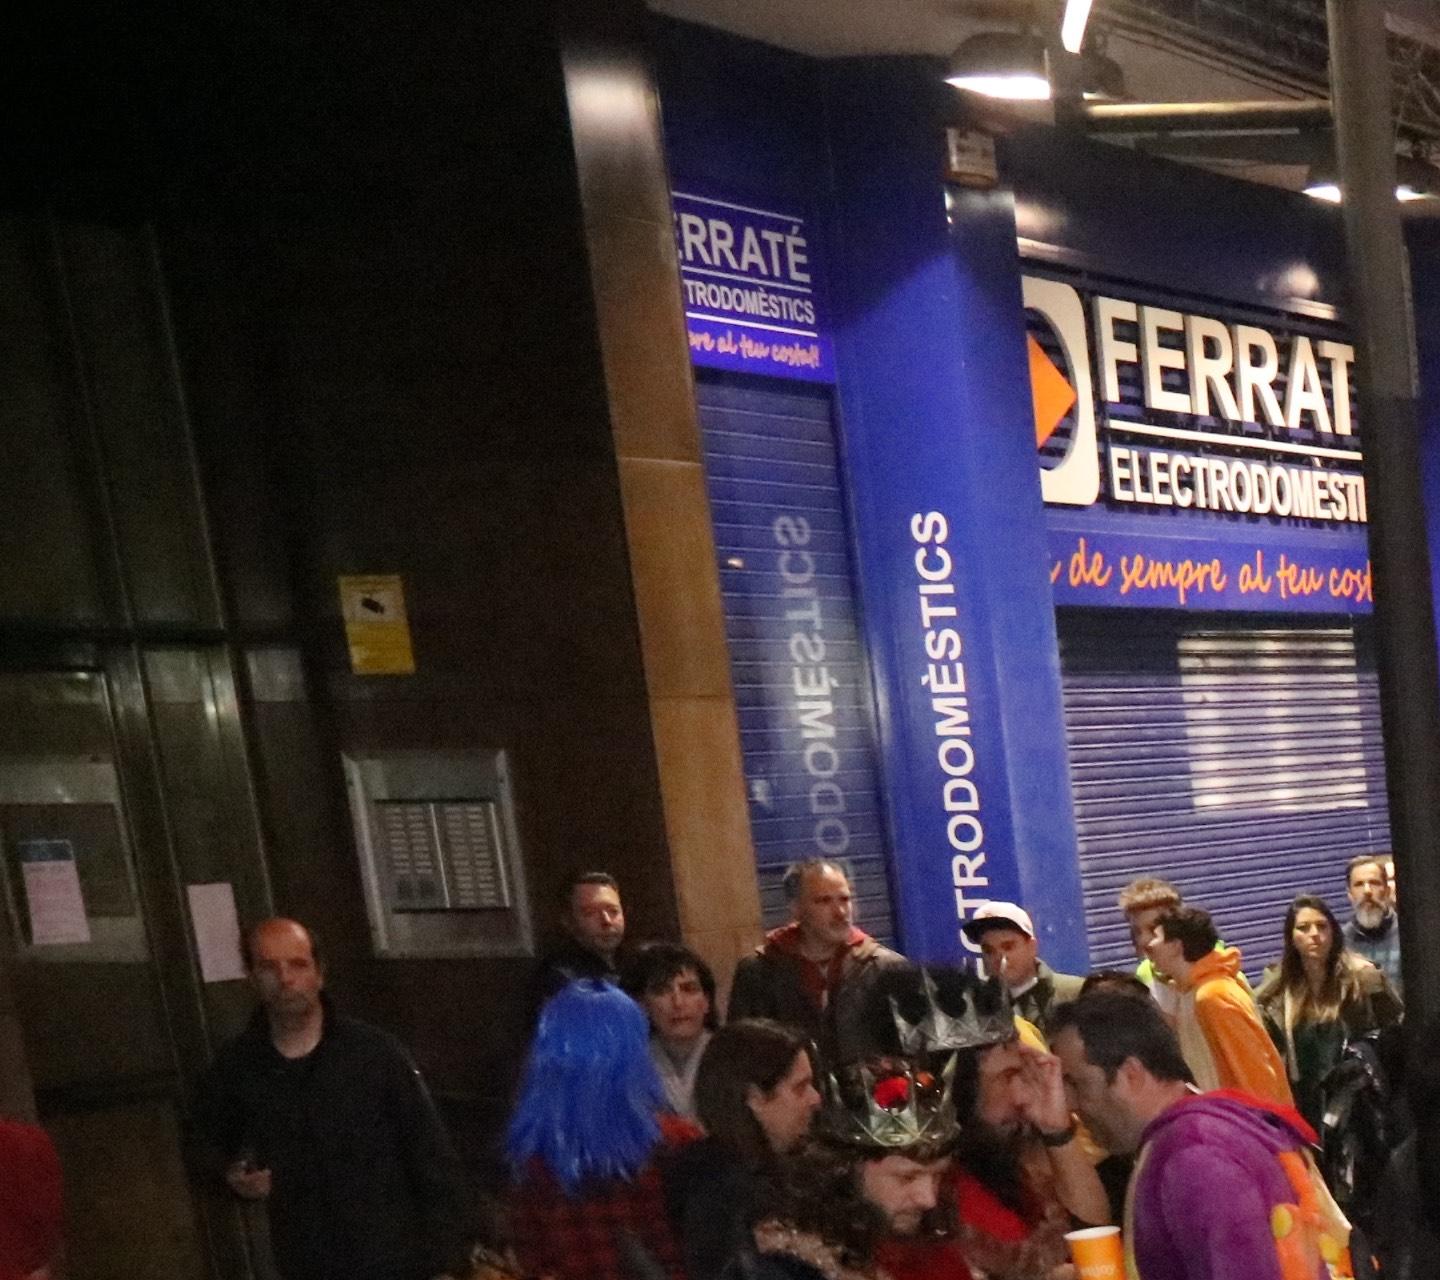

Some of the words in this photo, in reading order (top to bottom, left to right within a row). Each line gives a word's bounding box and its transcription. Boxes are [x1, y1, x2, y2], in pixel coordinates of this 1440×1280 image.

[675, 212, 811, 283] RRATÉ
[683, 280, 816, 325] TRODOMÈSTICS
[1094, 294, 1356, 436] FERRAT
[1109, 447, 1368, 523] ELECTRODOMÈSTI
[1070, 538, 1113, 587] de
[1119, 549, 1227, 604] sempre
[1238, 550, 1272, 594] al
[1277, 553, 1324, 599] teu
